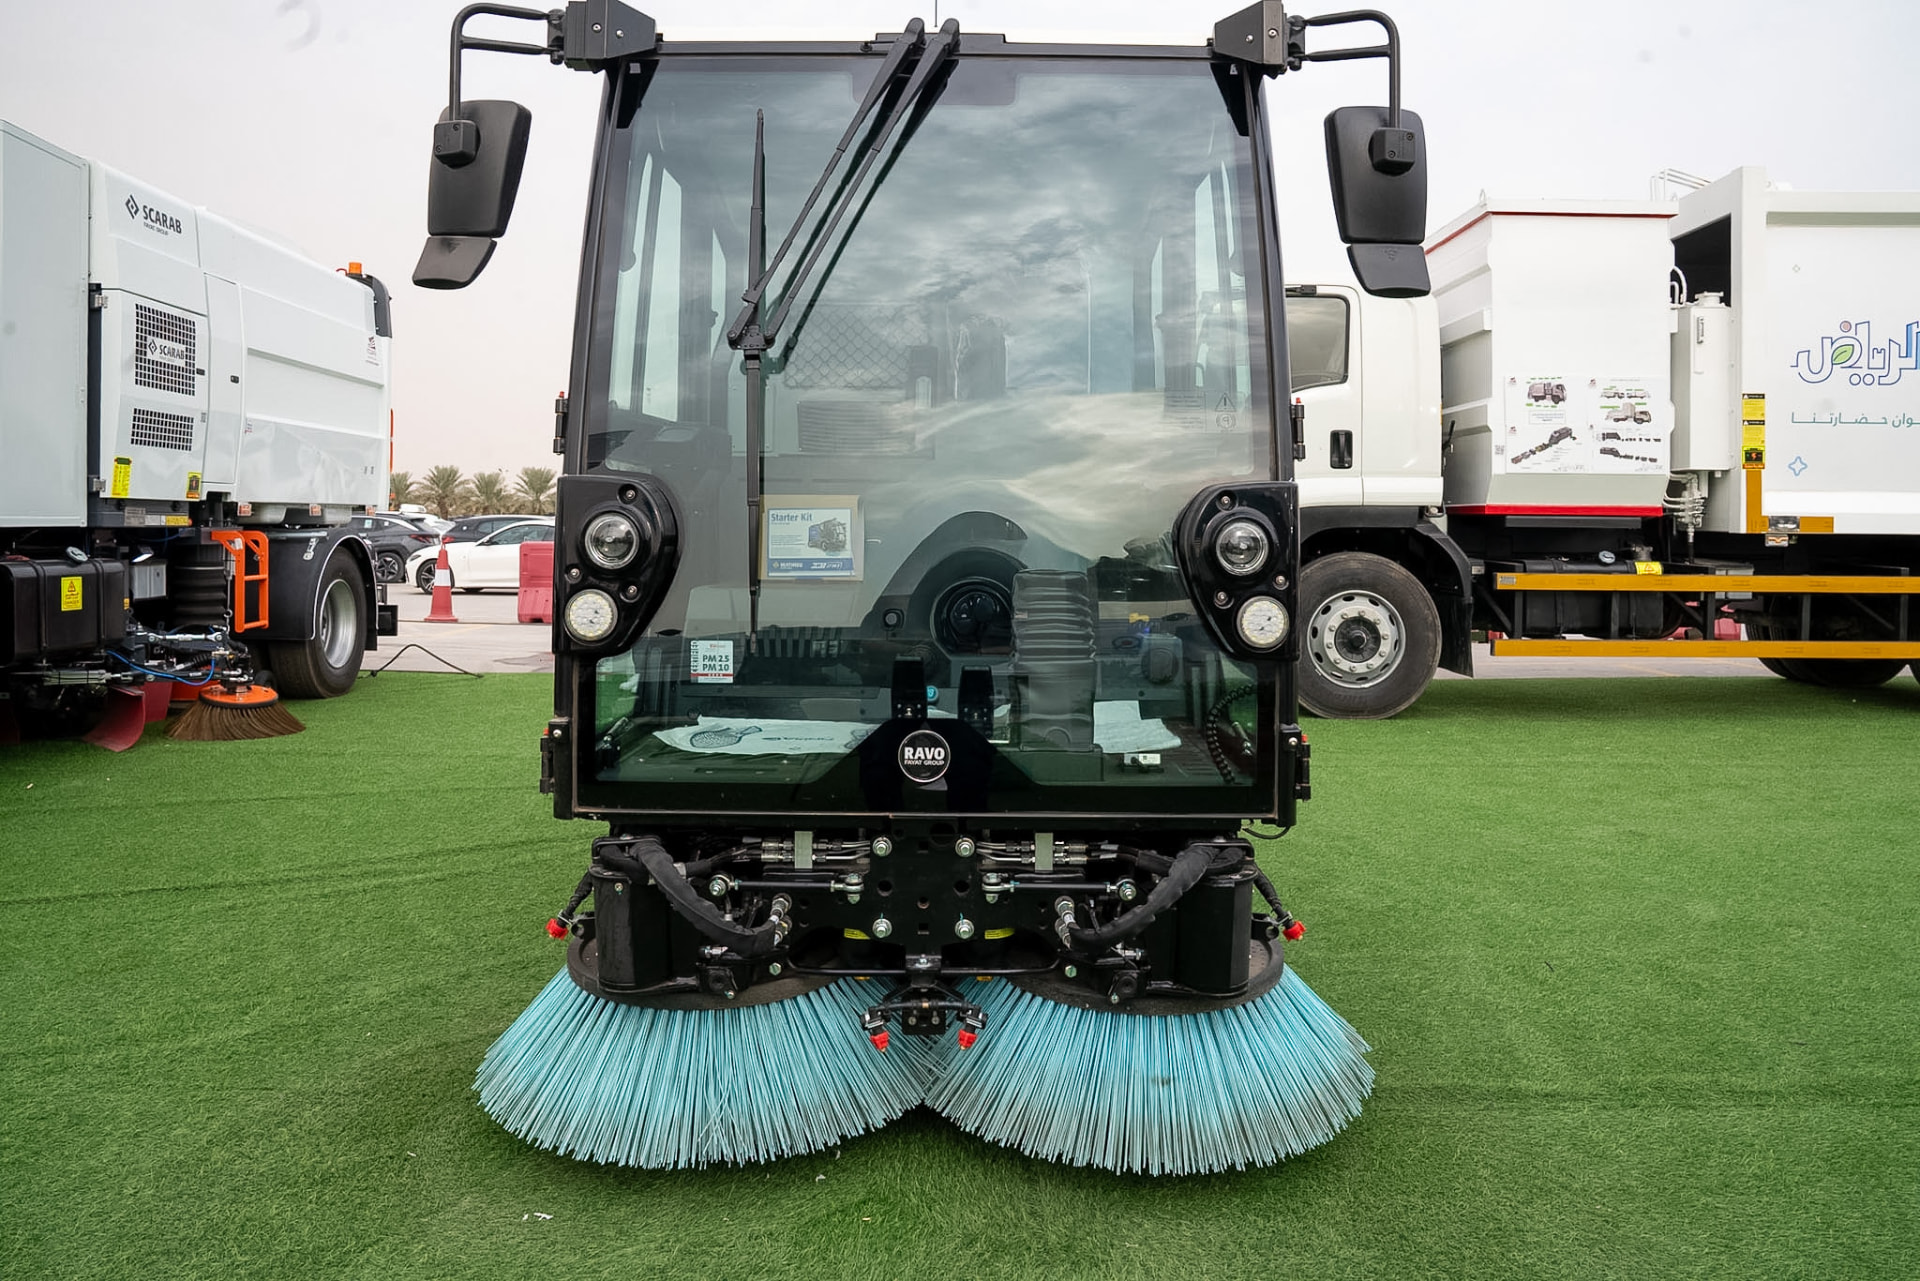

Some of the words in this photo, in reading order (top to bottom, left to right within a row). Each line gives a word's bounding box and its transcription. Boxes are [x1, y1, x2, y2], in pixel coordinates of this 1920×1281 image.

[142, 205, 182, 235] SCARAB
[159, 344, 185, 360] SCARAB
[1891, 412, 1920, 428] وان
[771, 513, 798, 521] Starter
[800, 512, 812, 521] Kit
[904, 747, 945, 760] RAVO
